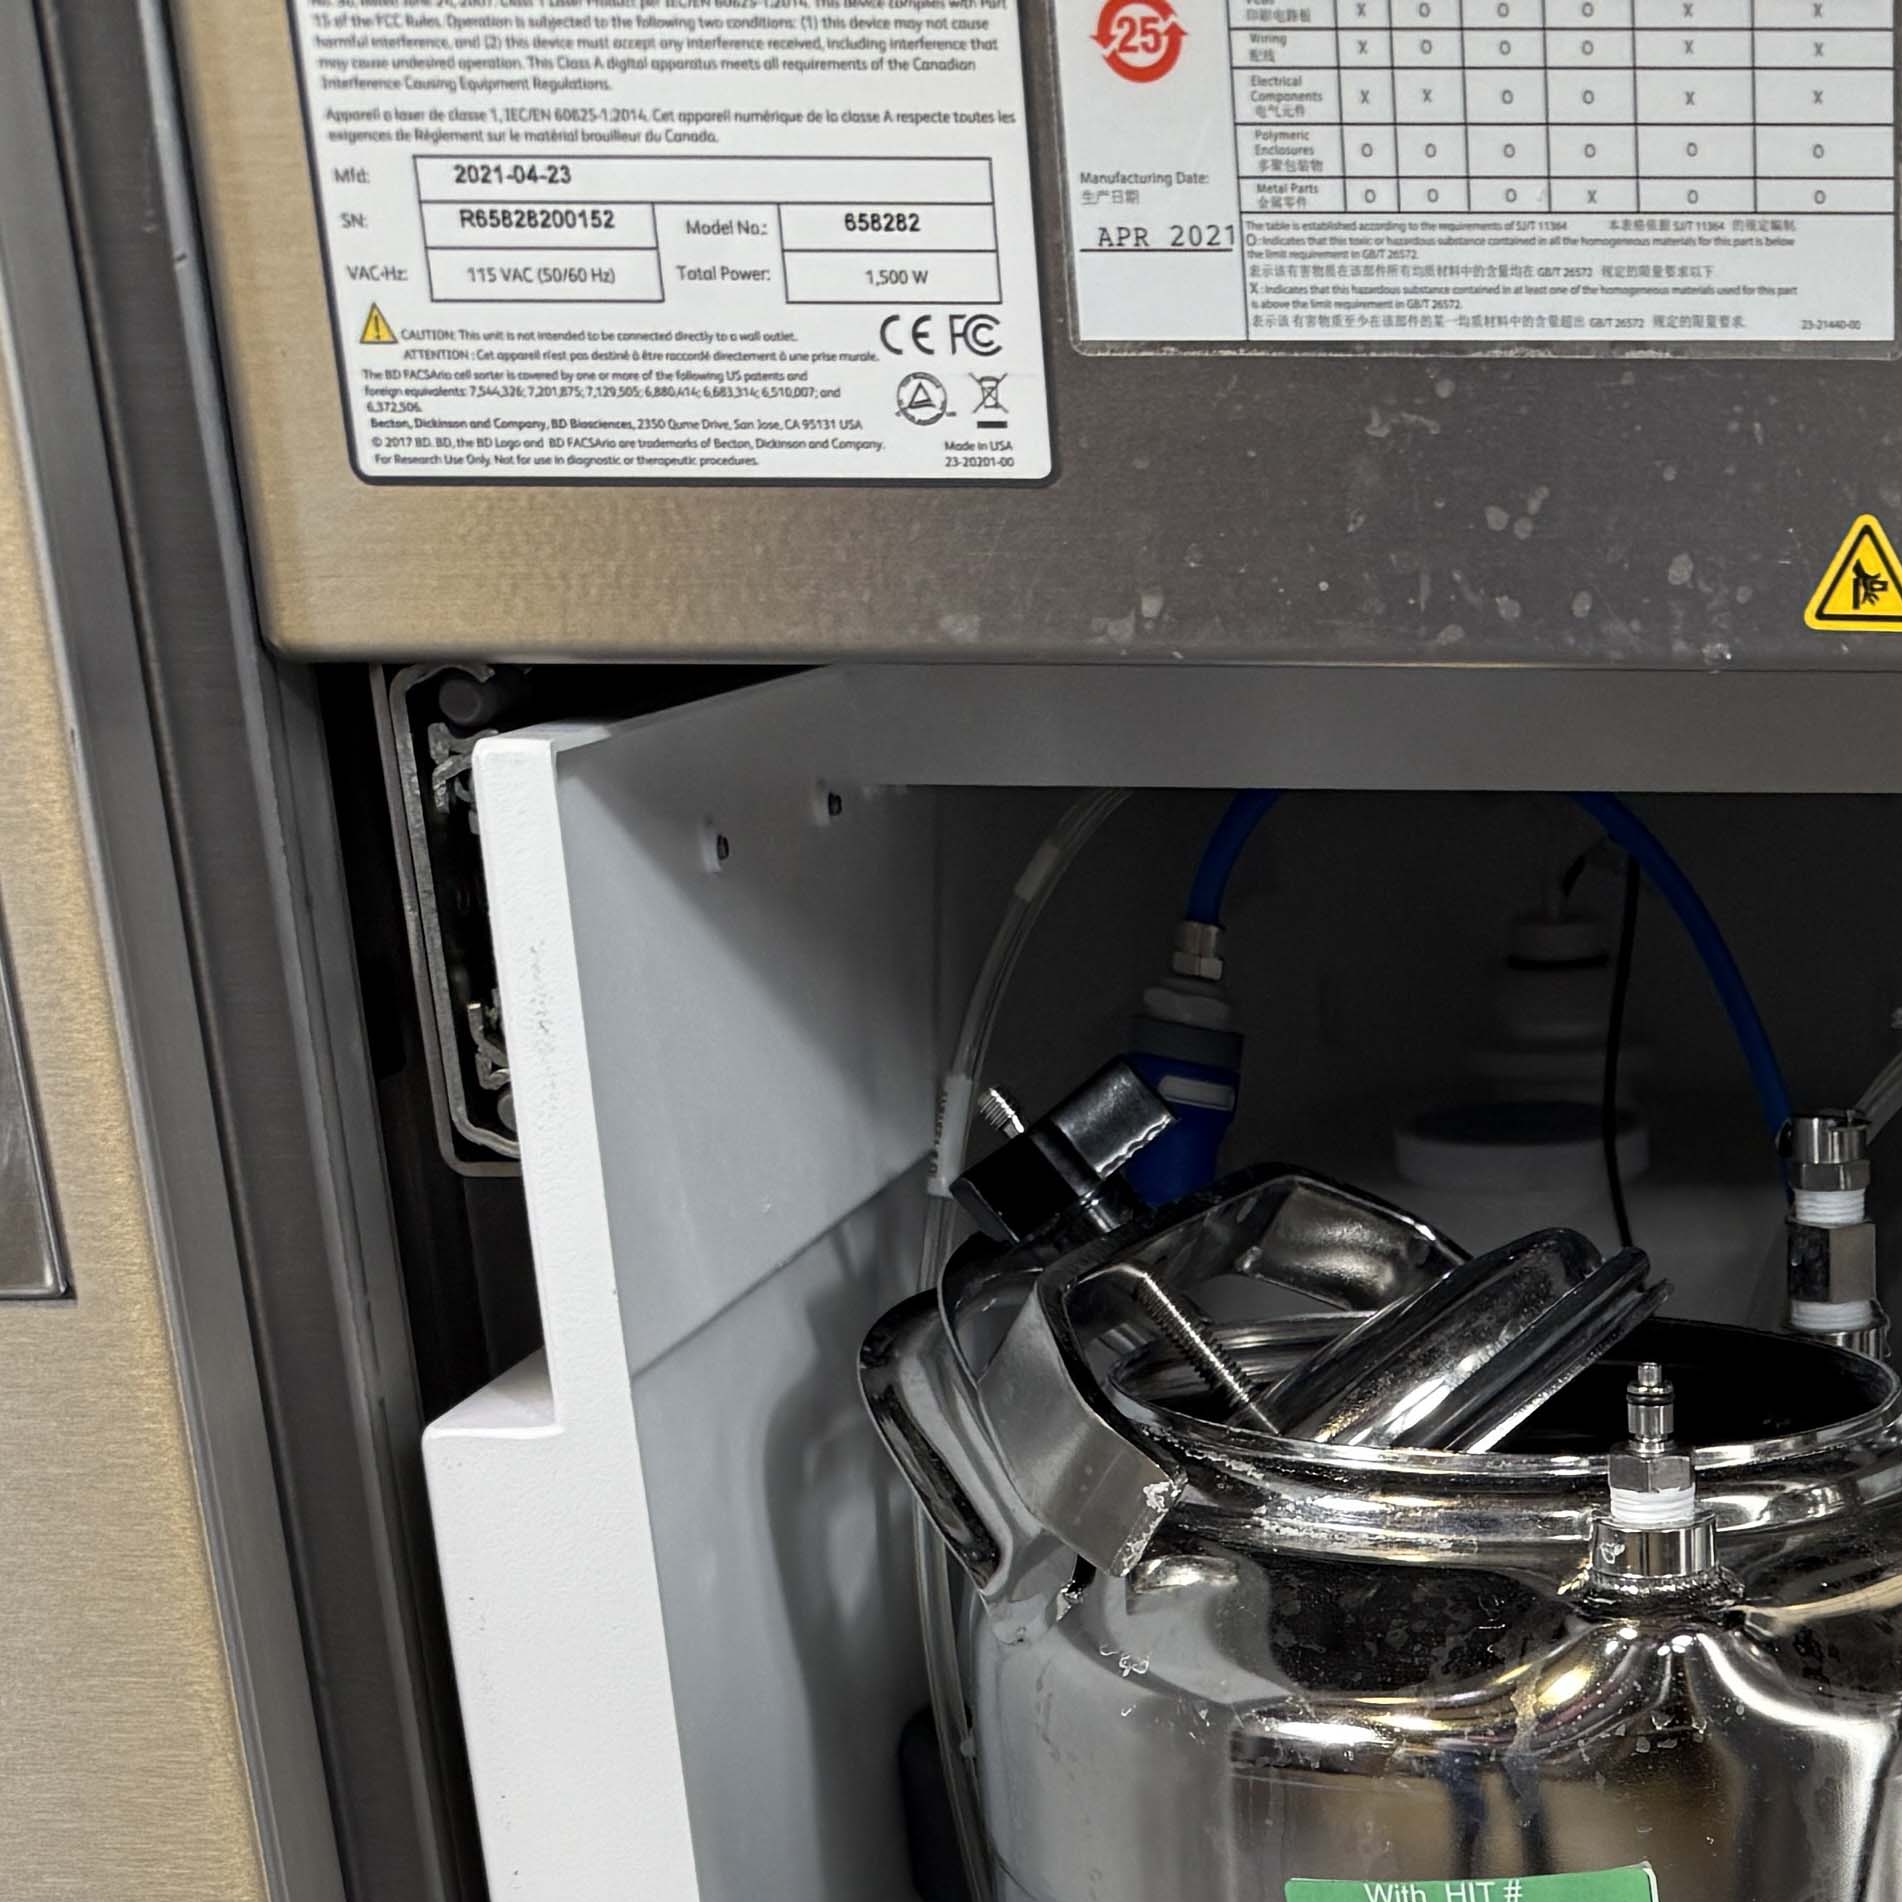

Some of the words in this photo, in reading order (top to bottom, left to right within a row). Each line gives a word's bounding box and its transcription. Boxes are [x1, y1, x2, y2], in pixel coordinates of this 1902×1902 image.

[1116, 16, 1162, 54] 25
[1249, 33, 1287, 47] Wiring
[1250, 75, 1302, 87] Electrical
[1250, 91, 1322, 104] Components
[1255, 130, 1310, 142] Polymeric
[1254, 144, 1315, 156] Enclosures
[453, 164, 571, 184] 2021-04-23
[1080, 172, 1172, 186] Manufacturing
[1175, 172, 1208, 184] Date:
[1257, 183, 1287, 194] Metal
[1291, 183, 1318, 194] Parts
[339, 212, 367, 228] SN:
[459, 209, 614, 228] R65828200152
[844, 213, 920, 232] 658282
[685, 220, 732, 235] Model
[737, 220, 767, 235] No.:
[1098, 226, 1149, 247] APR
[1170, 224, 1234, 248] 2021
[467, 267, 496, 283] 115
[499, 267, 533, 283] VAC
[536, 267, 587, 283] (50/60
[590, 268, 615, 284] Hz)
[675, 265, 716, 280] Total
[720, 266, 770, 280] Power:
[865, 269, 908, 286] 1,500
[912, 270, 928, 284] W
[458, 329, 480, 340] This
[483, 331, 502, 341] unit
[517, 331, 534, 341] not
[587, 331, 599, 341] to
[601, 331, 614, 341] be
[675, 331, 713, 343] directly
[716, 332, 727, 341] to
[739, 330, 760, 341] wall
[880, 314, 935, 355] CE
[414, 418, 467, 428] Dickinson
[469, 418, 491, 428] and
[493, 418, 549, 431] Company,
[550, 418, 567, 429] BD
[637, 418, 665, 429] 2350
[701, 418, 731, 430] Drive,
[733, 418, 754, 430] San
[784, 418, 800, 430] CA
[802, 419, 835, 430] 95131
[839, 419, 862, 430] USA
[944, 441, 975, 451] Made
[989, 440, 1013, 451] USA
[374, 453, 391, 464] For
[394, 454, 441, 464] Research
[444, 454, 463, 464] Use
[466, 454, 490, 467] Only.
[494, 454, 513, 464] Not
[516, 454, 530, 465] for
[534, 457, 551, 465] use
[567, 455, 620, 467] diagnostic
[623, 457, 633, 465] or
[636, 456, 696, 466] therapeutic
